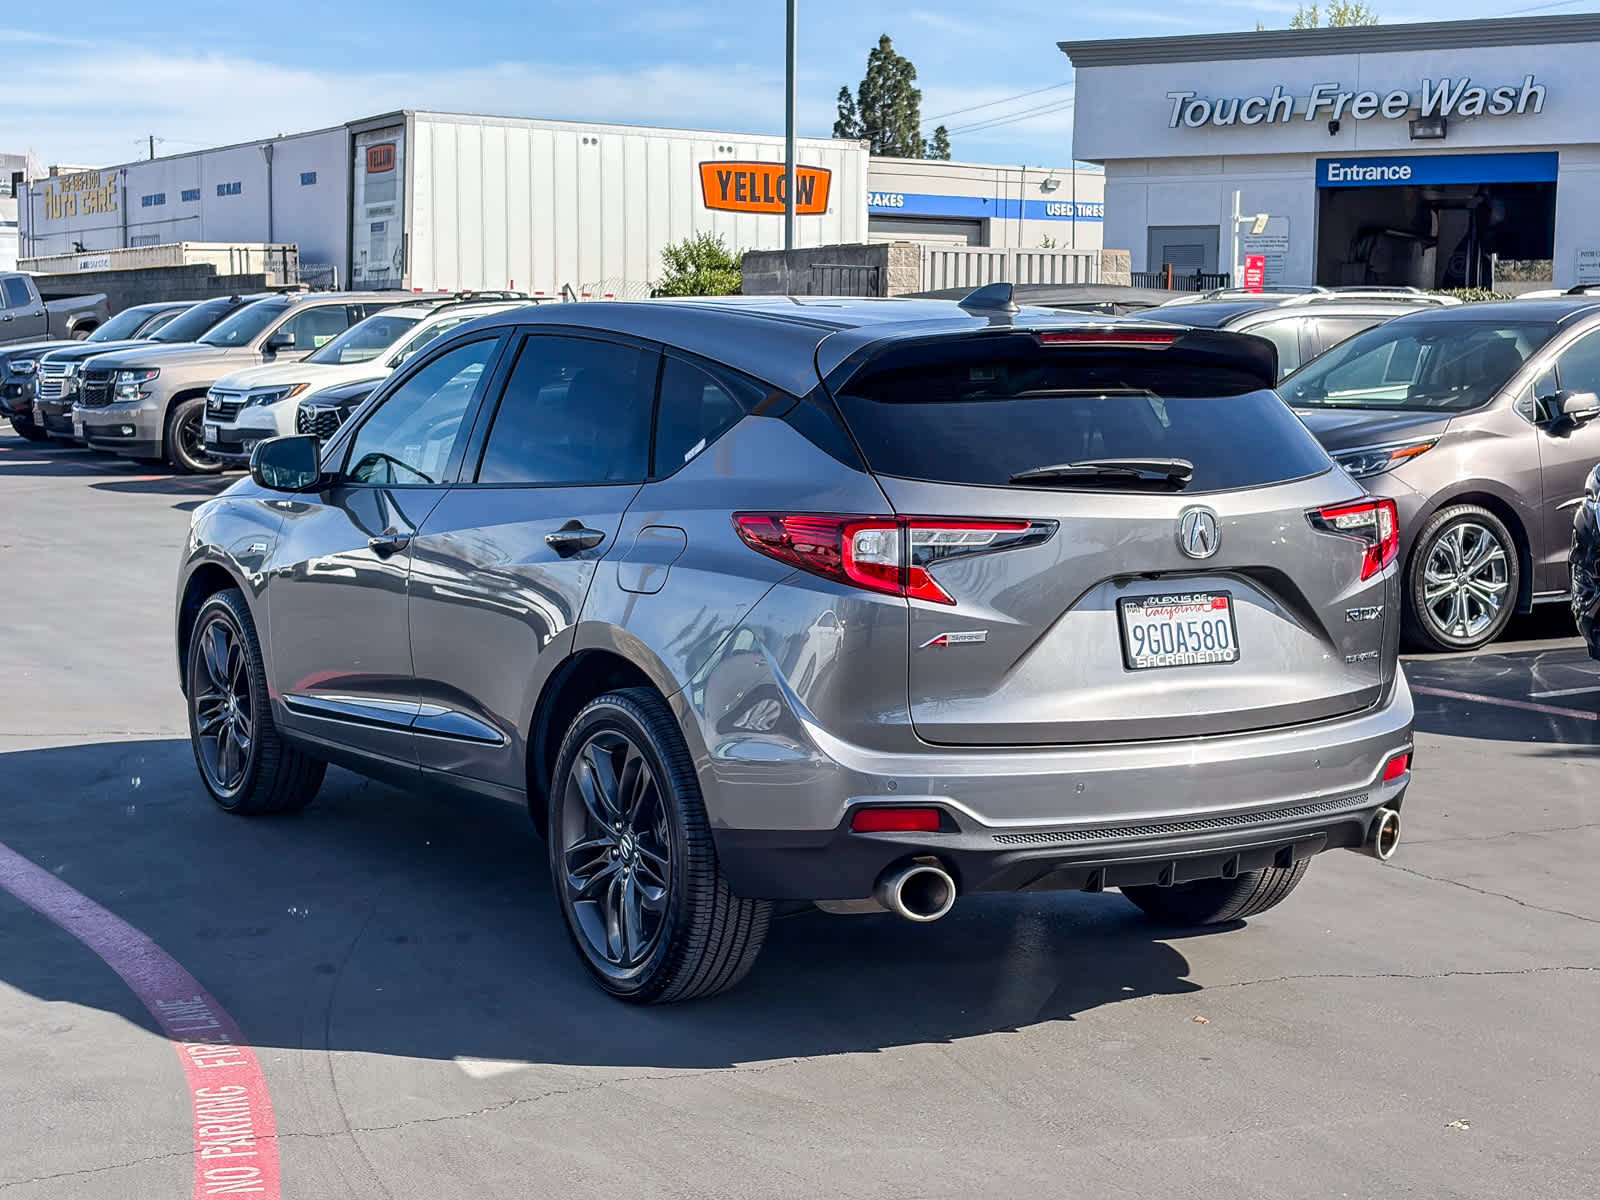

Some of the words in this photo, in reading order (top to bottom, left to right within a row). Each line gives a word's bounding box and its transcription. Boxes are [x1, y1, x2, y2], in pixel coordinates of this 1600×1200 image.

[1167, 86, 1295, 129] Touch
[1304, 82, 1410, 121] Free
[1420, 74, 1548, 119] Wash
[1327, 162, 1412, 183] Entrance
[717, 170, 816, 206] YELLOW
[868, 192, 905, 208] RAKES
[1046, 203, 1074, 216] USED
[1076, 204, 1104, 218] TIRES
[1157, 595, 1192, 605] LEXUS
[1193, 594, 1208, 602] OF
[1136, 648, 1234, 669] SACRAMENTO
[195, 1085, 259, 1160] PARKING
[203, 1166, 265, 1195] NO
